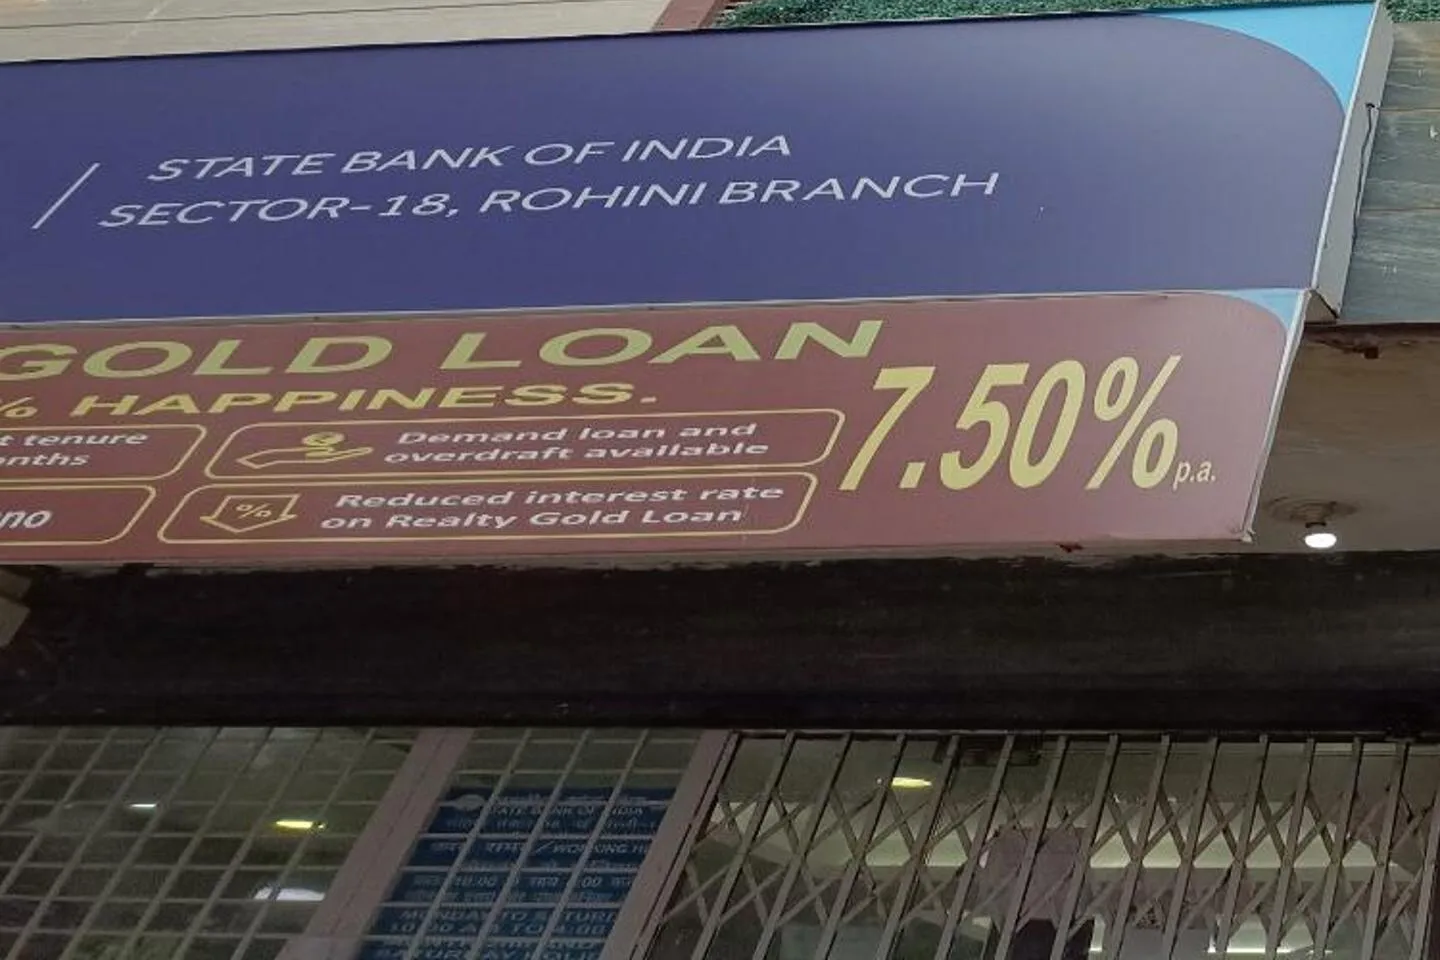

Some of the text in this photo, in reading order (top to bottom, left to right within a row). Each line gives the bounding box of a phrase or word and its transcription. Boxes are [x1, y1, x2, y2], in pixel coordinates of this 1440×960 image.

[147, 135, 792, 181] STATE BANK OF INDIA
[97, 171, 1000, 229] SECTOR-18, ROHINI BRANCH
[0, 320, 884, 382] GOLD LOAN
[69, 382, 657, 417] HAPPINESS.
[839, 353, 1217, 491] 7.50% p.a.
[24, 431, 149, 446] tenure
[398, 423, 757, 444] Demand loan and
[0, 452, 90, 466] nths
[383, 442, 769, 463] overdraft available
[336, 487, 785, 508] Reduced interest rate
[321, 509, 743, 529] on Realty Gold Loan
